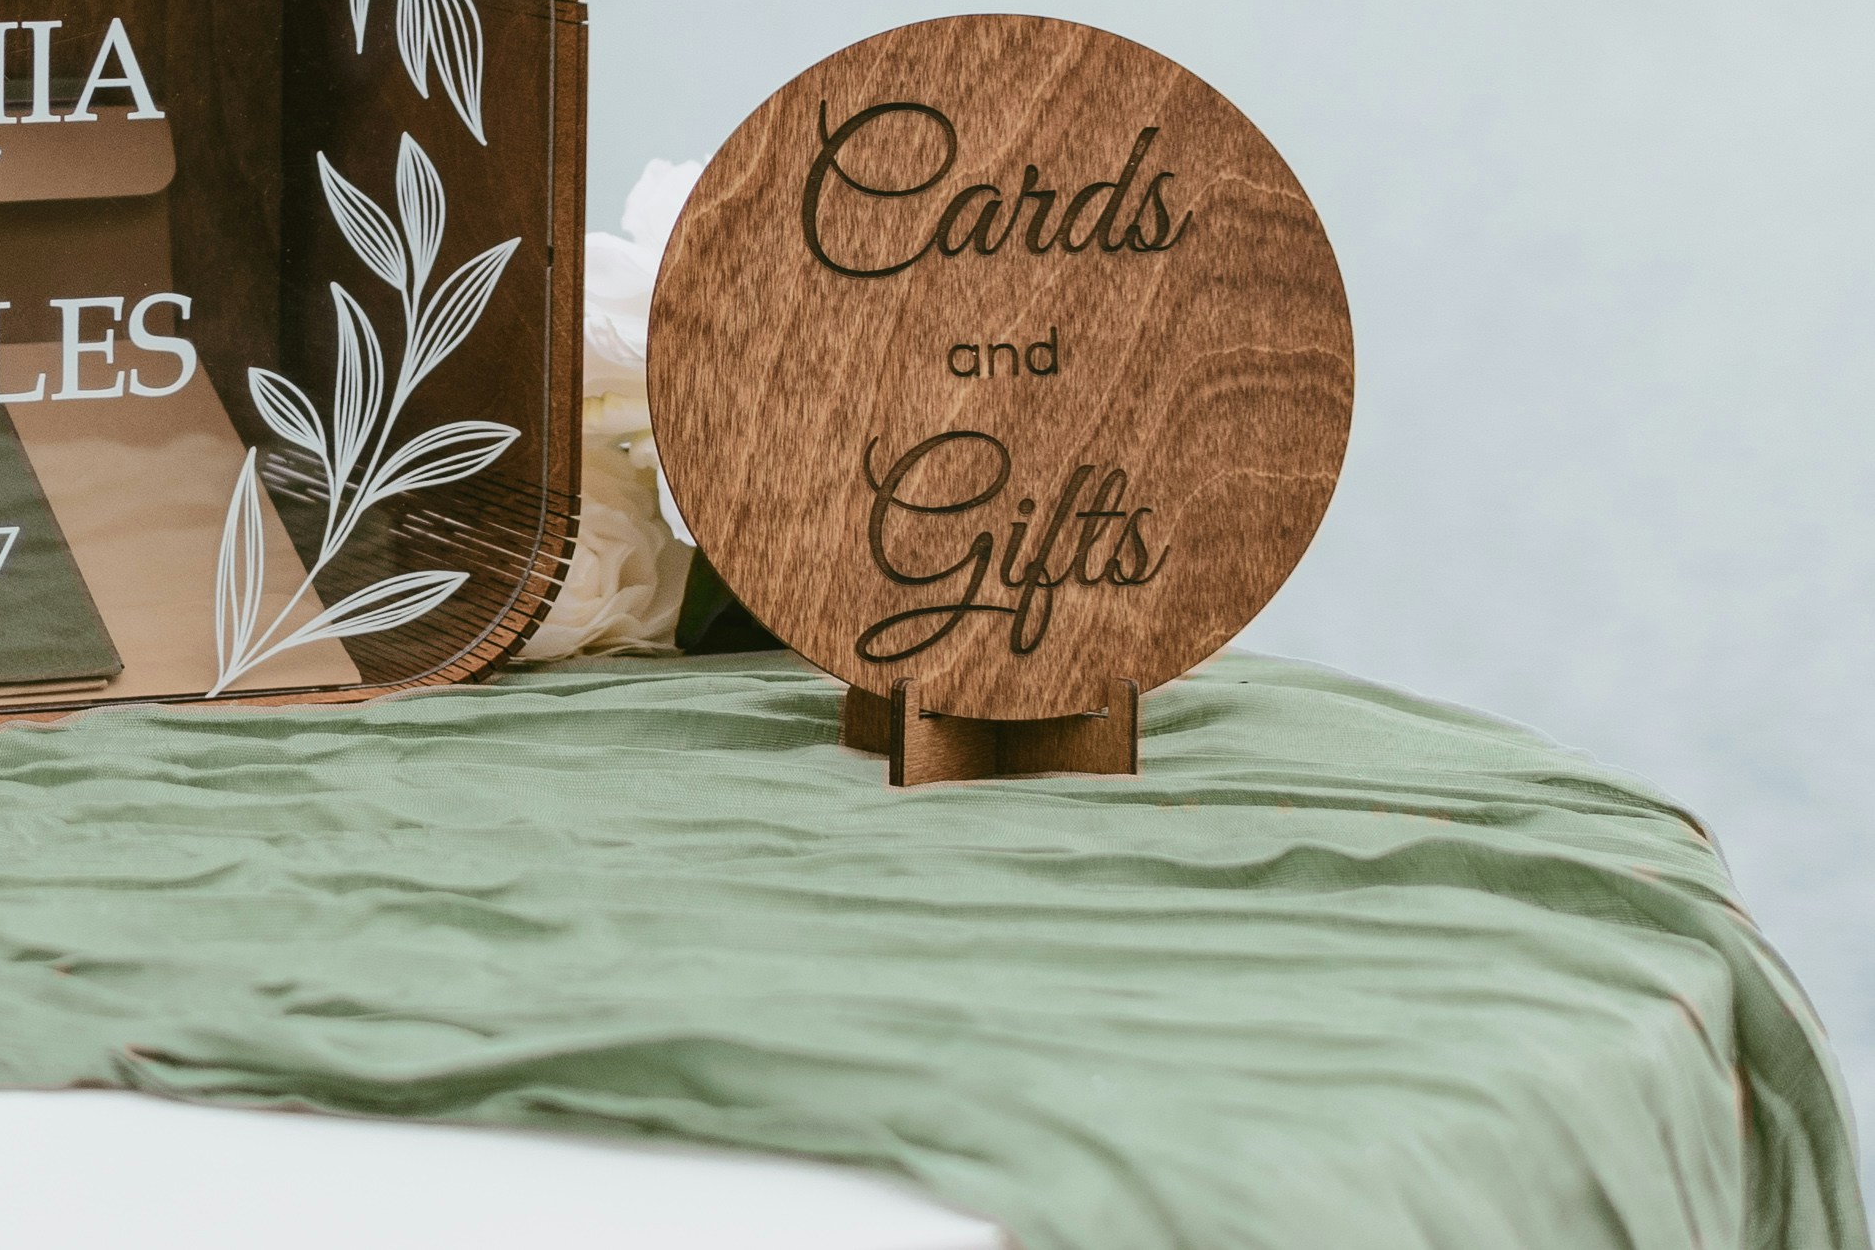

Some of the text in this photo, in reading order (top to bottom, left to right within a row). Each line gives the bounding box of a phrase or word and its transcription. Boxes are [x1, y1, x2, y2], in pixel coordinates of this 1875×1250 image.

[801, 98, 1193, 279] Cards
[946, 327, 1060, 378] and
[854, 430, 1171, 664] Gifts
